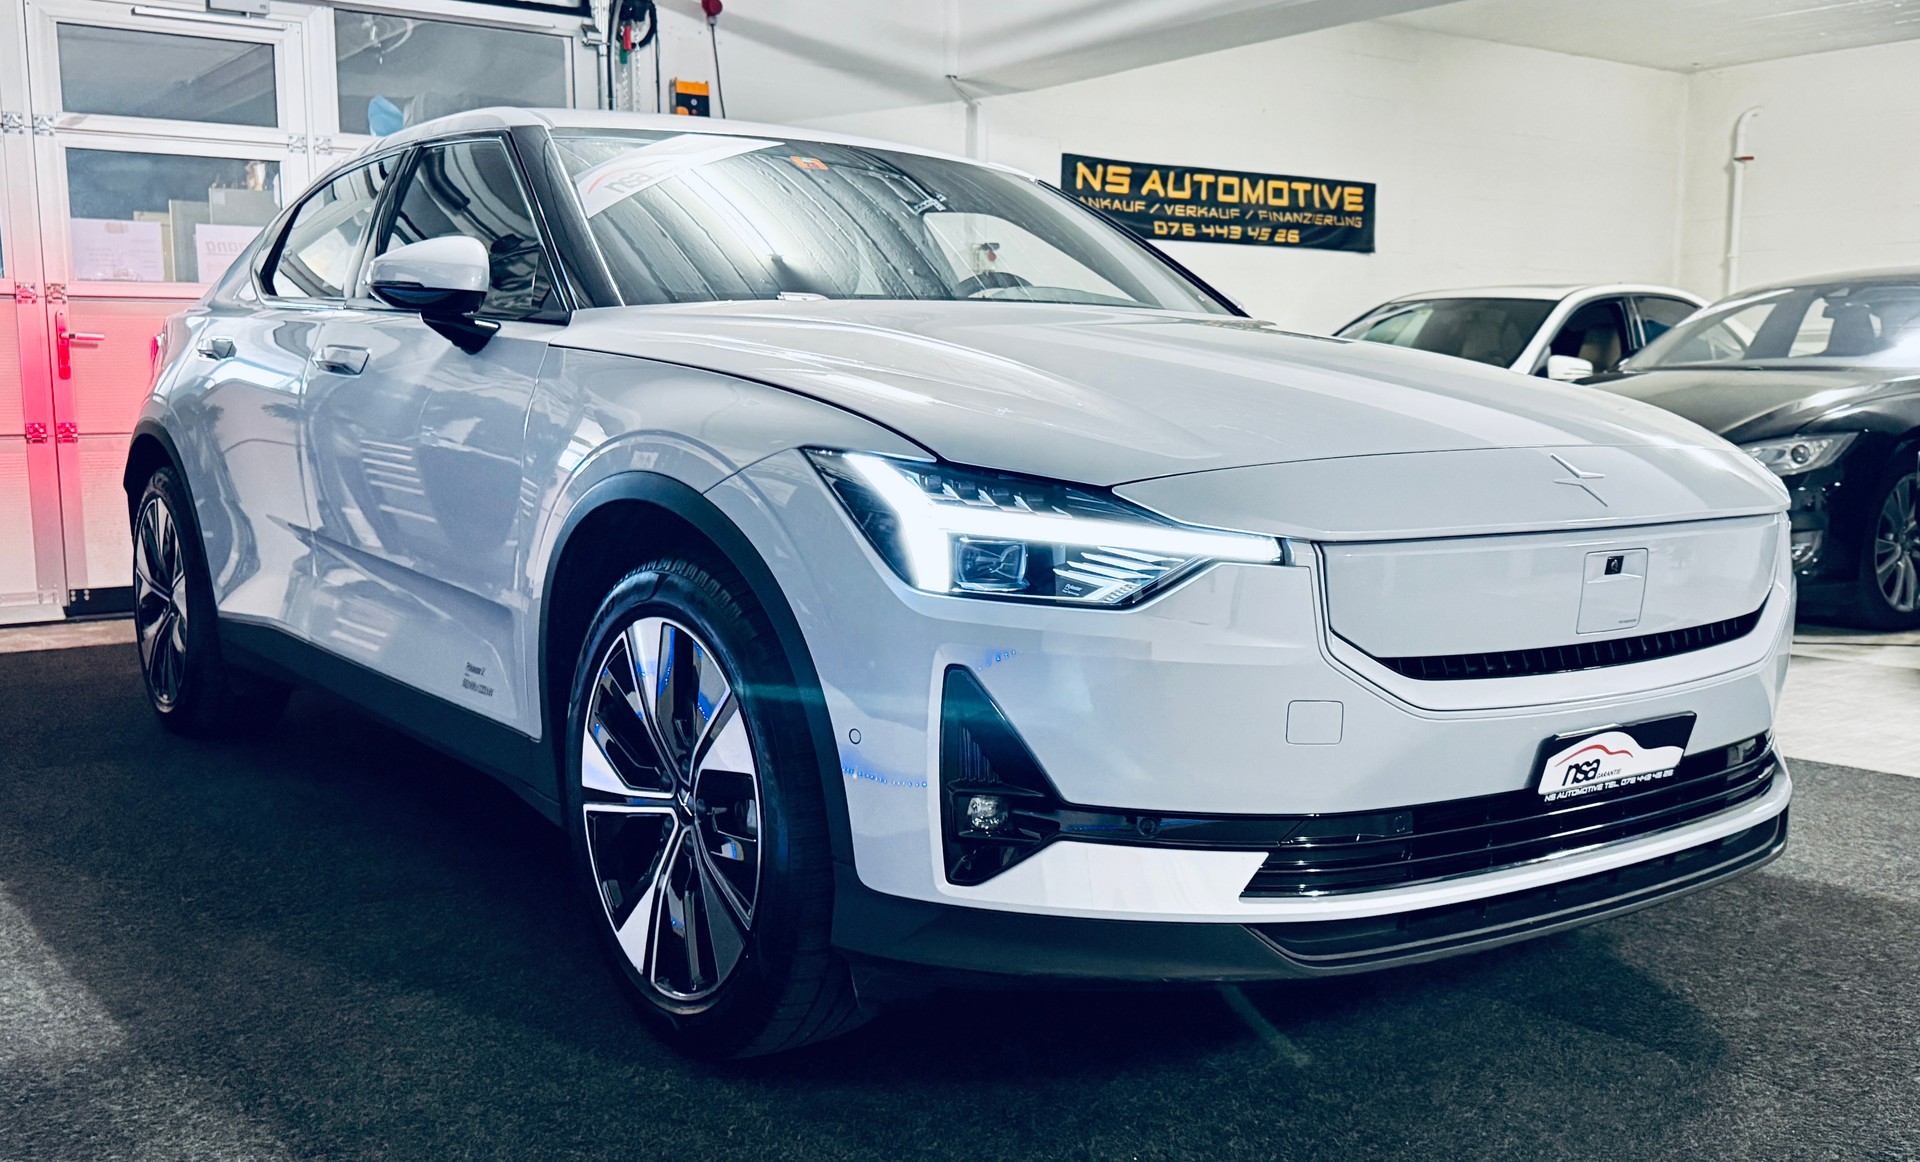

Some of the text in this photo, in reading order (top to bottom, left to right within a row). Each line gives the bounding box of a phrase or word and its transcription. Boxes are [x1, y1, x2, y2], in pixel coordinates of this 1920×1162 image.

[1075, 161, 1364, 212] NS AUTOMOTIVE
[1165, 204, 1241, 220] VERKAUF
[1258, 209, 1362, 228] FINANZIERUNG
[1153, 220, 1300, 243] 076 443 45 26
[1562, 758, 1601, 787] nsa
[1556, 783, 1604, 799] AUTOMOTIVE
